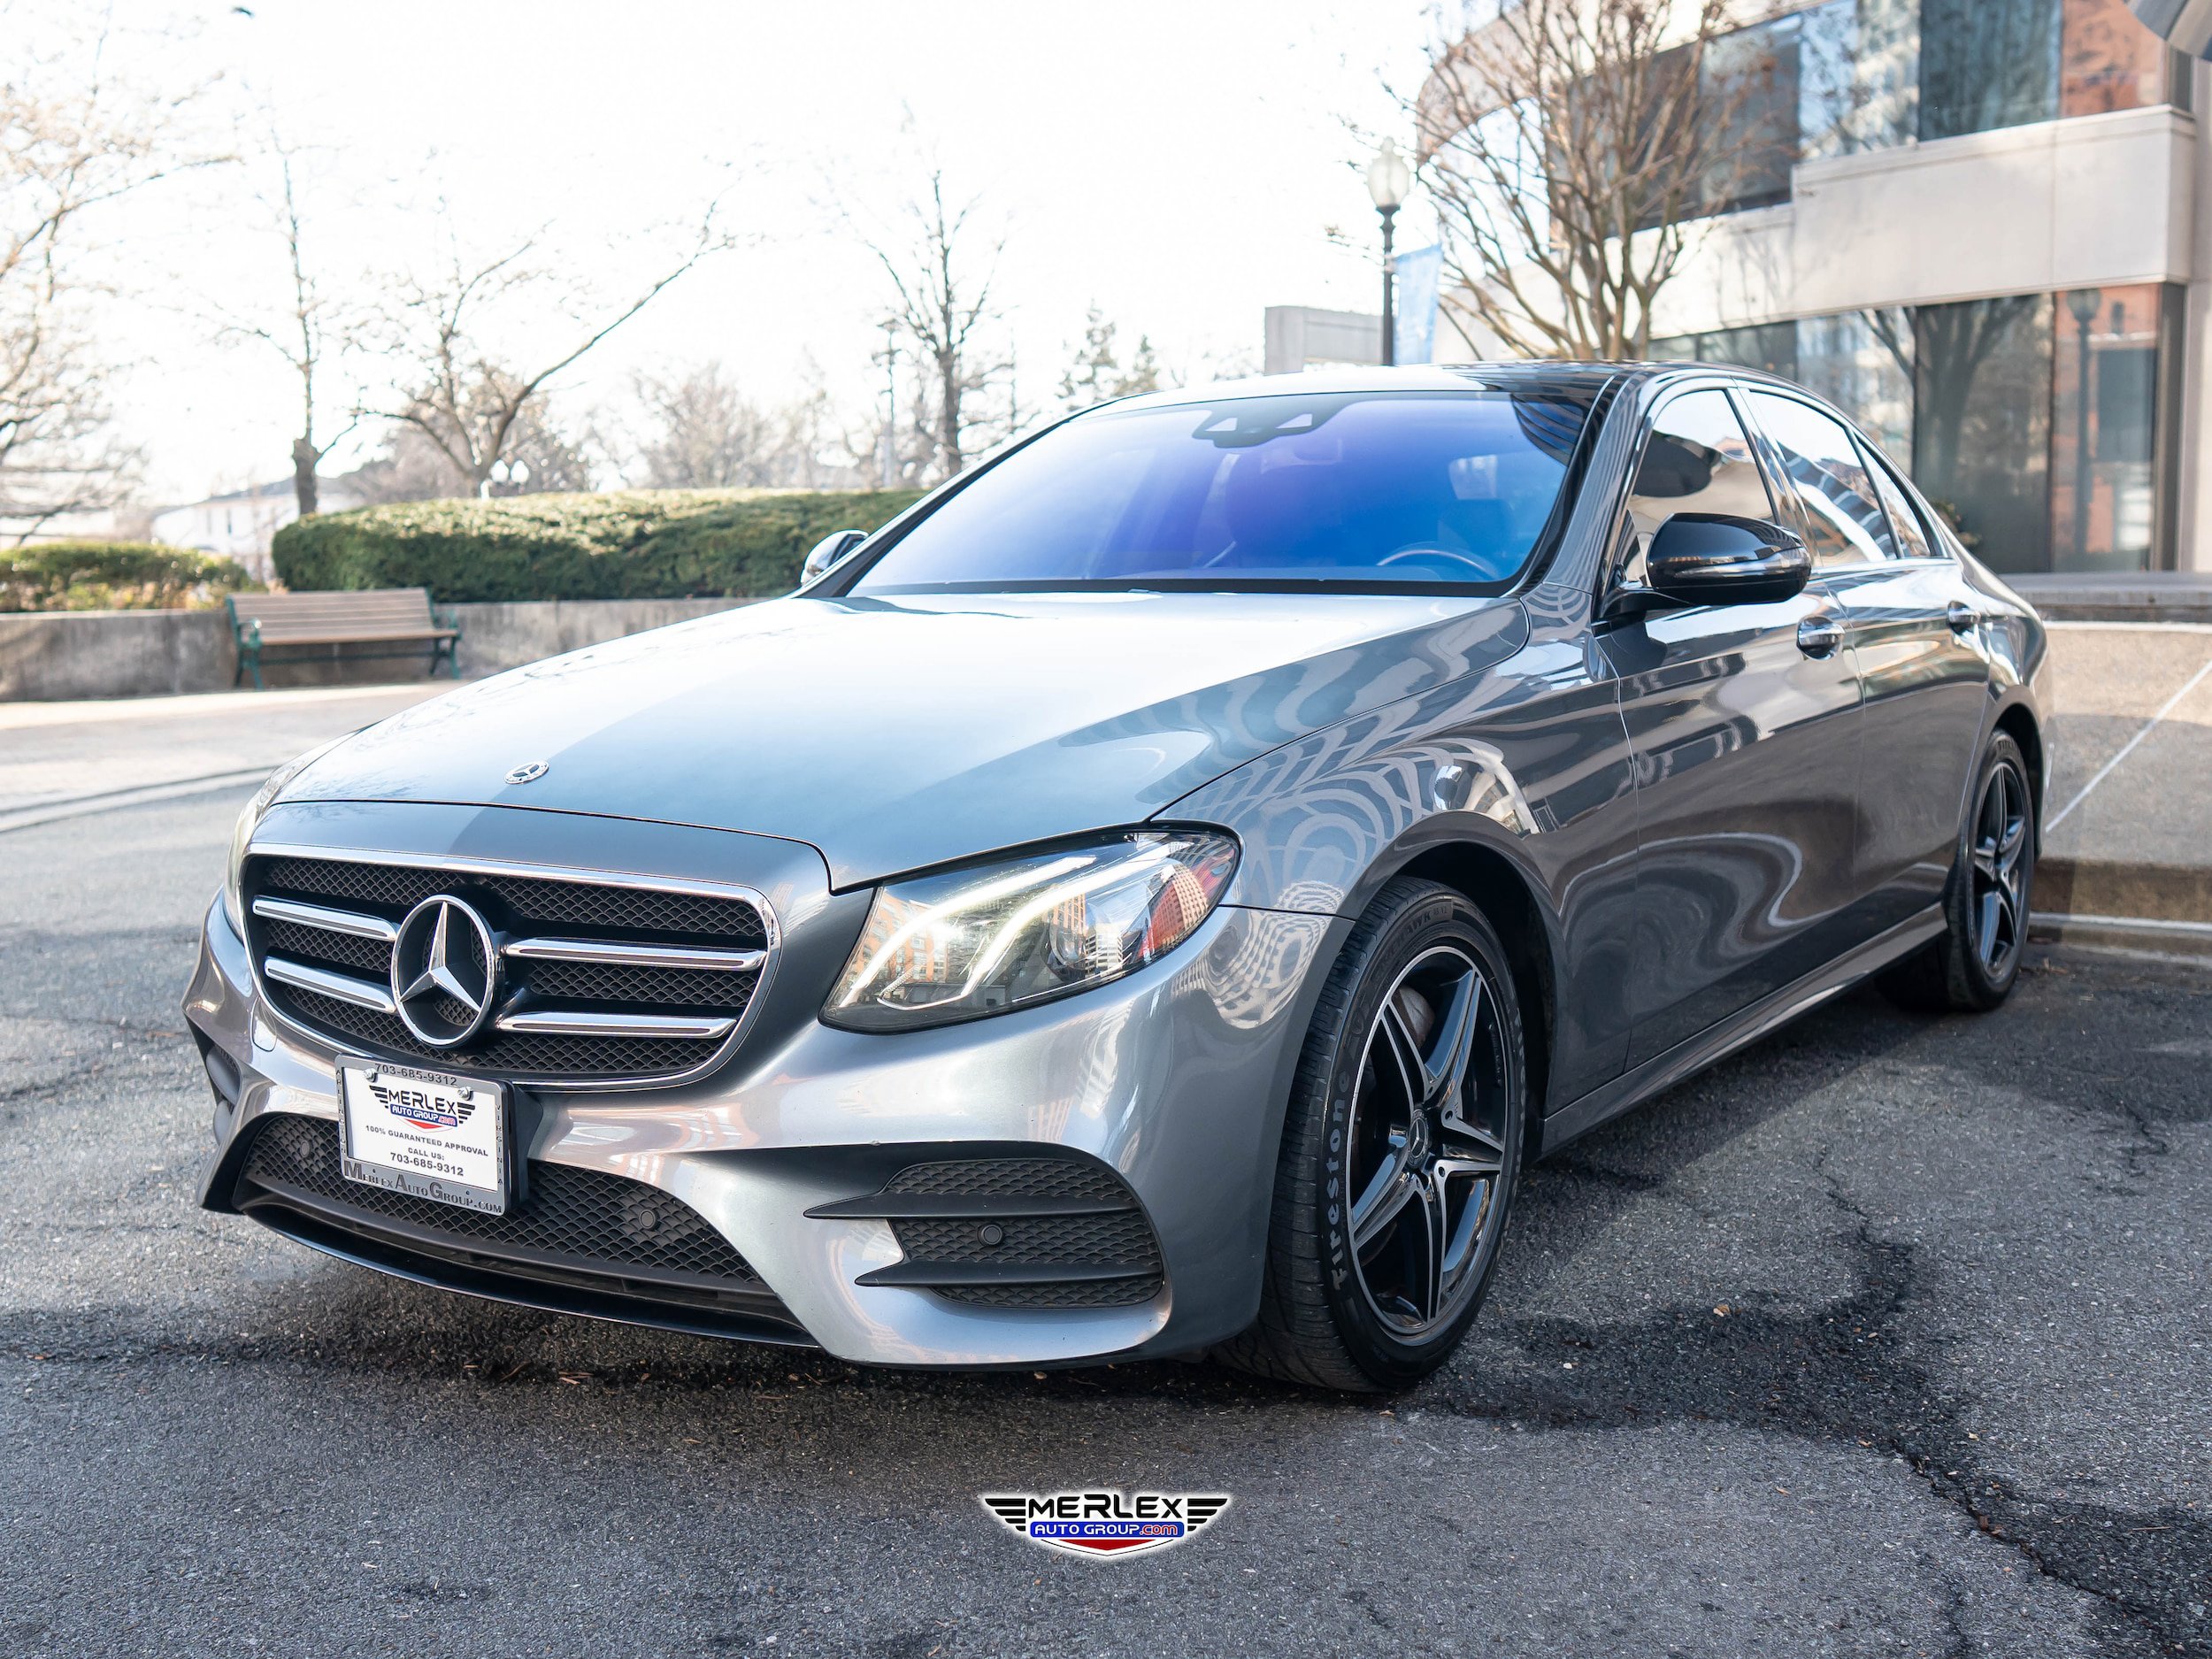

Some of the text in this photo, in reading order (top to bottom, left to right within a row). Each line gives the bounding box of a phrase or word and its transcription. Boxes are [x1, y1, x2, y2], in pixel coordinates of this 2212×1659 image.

[375, 1063, 457, 1086] 703-685-9312
[388, 1089, 457, 1116] MERLEX
[392, 1107, 412, 1118] AUTO
[365, 1125, 488, 1156] 100% GUARANTEED APPROVAL
[390, 1152, 464, 1177] 703-685-9312
[408, 1147, 445, 1161] CALL US:
[1325, 1070, 1351, 1291] Firestone
